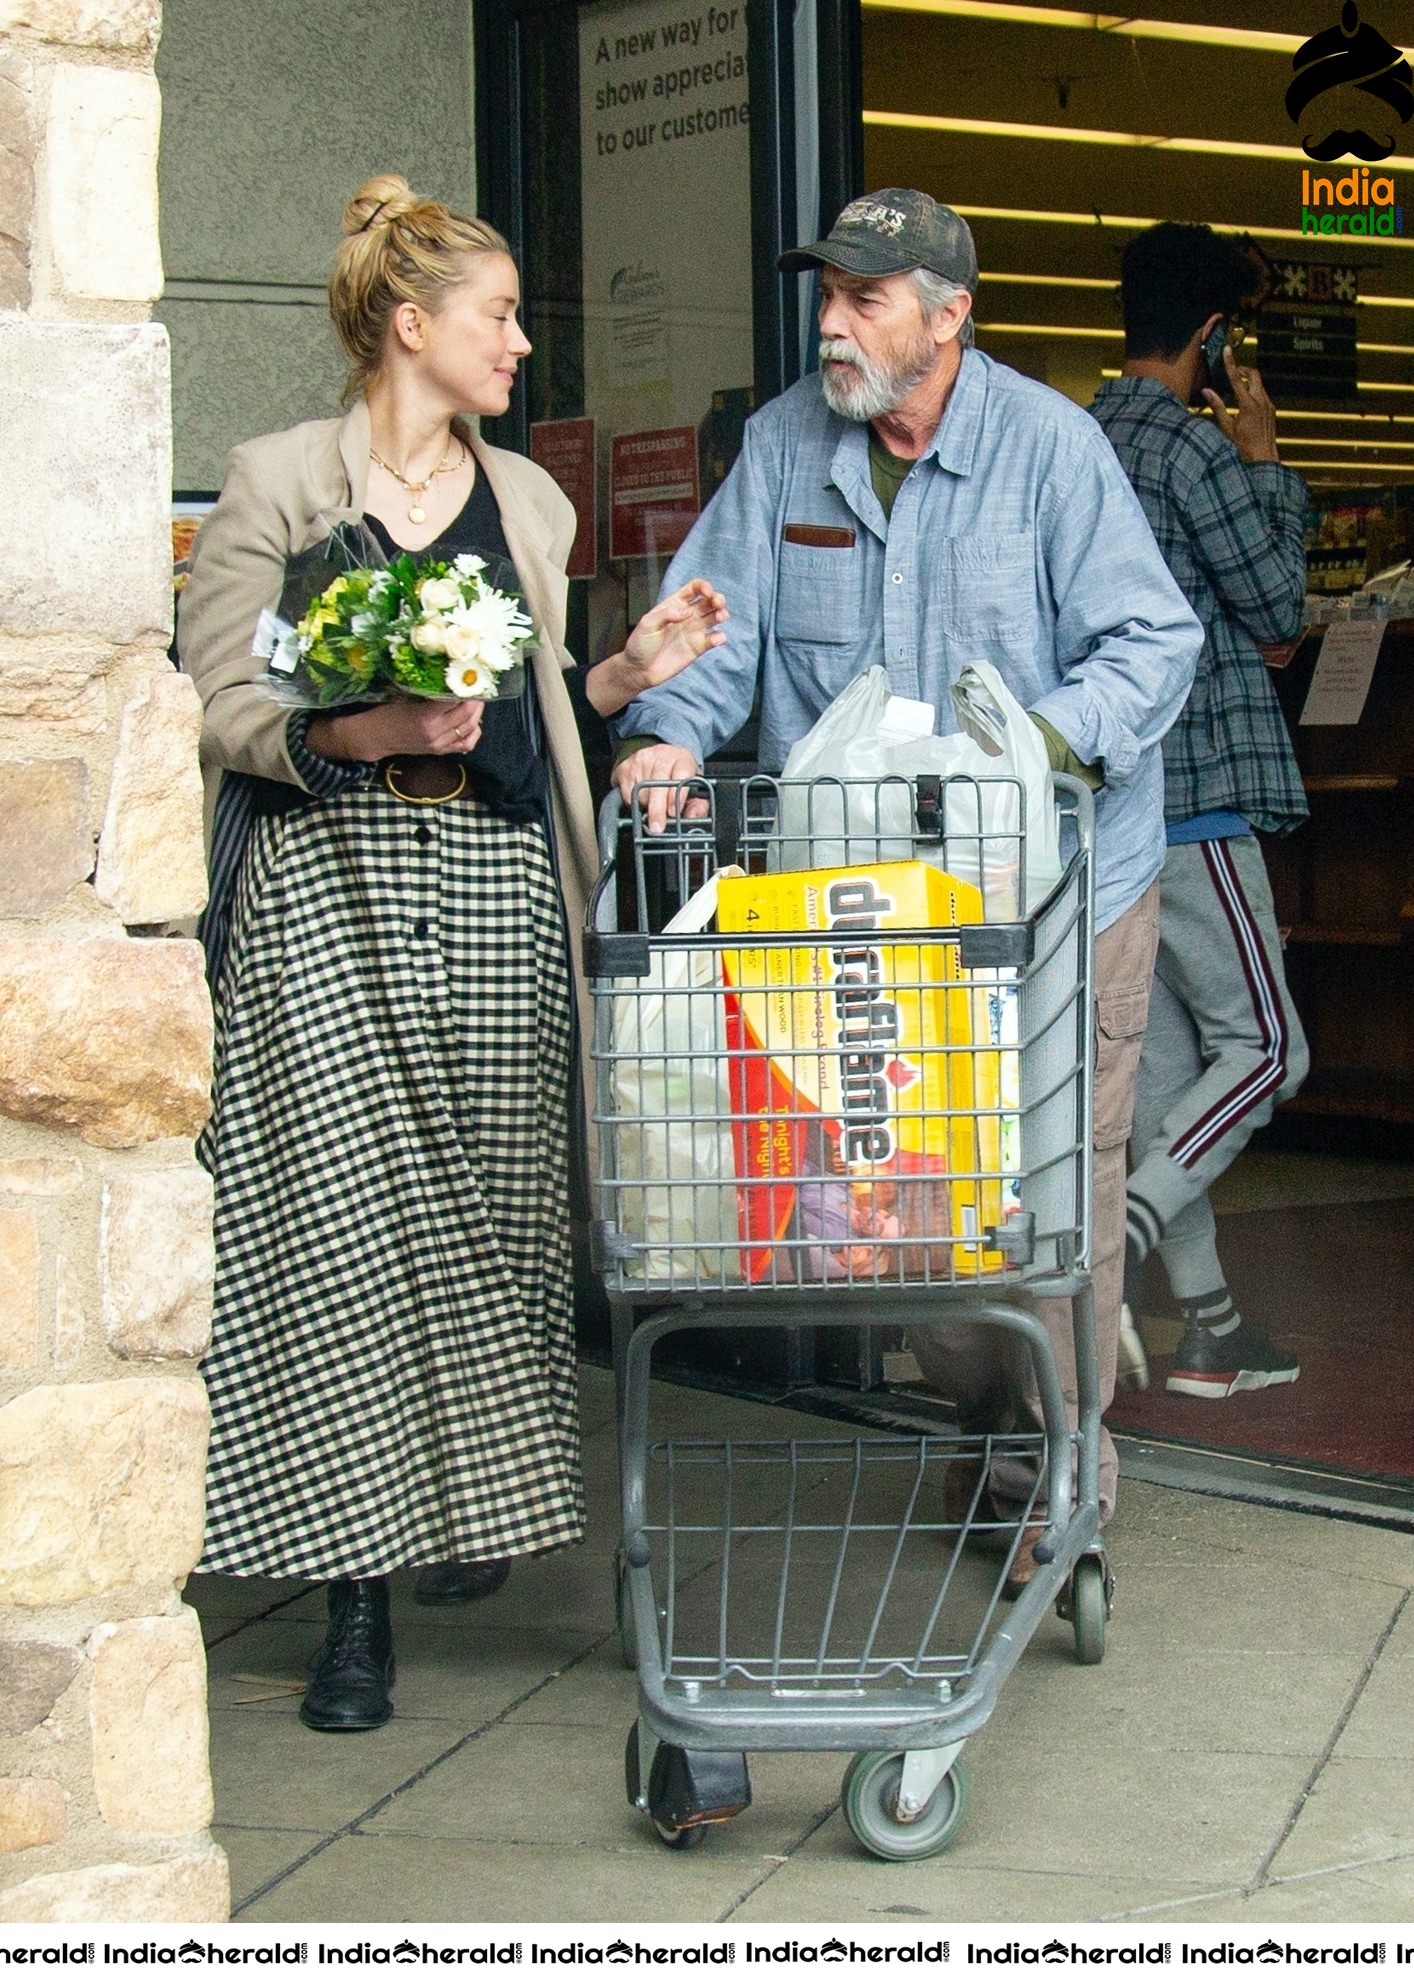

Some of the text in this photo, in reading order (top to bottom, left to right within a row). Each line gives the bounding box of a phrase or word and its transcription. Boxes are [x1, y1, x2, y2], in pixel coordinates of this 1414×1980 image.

[595, 6, 739, 65] A new way for
[596, 79, 648, 110] show
[596, 129, 617, 156] to
[622, 123, 657, 150] our
[829, 881, 898, 1162] duraflame
[772, 1104, 793, 1176] Tnight's
